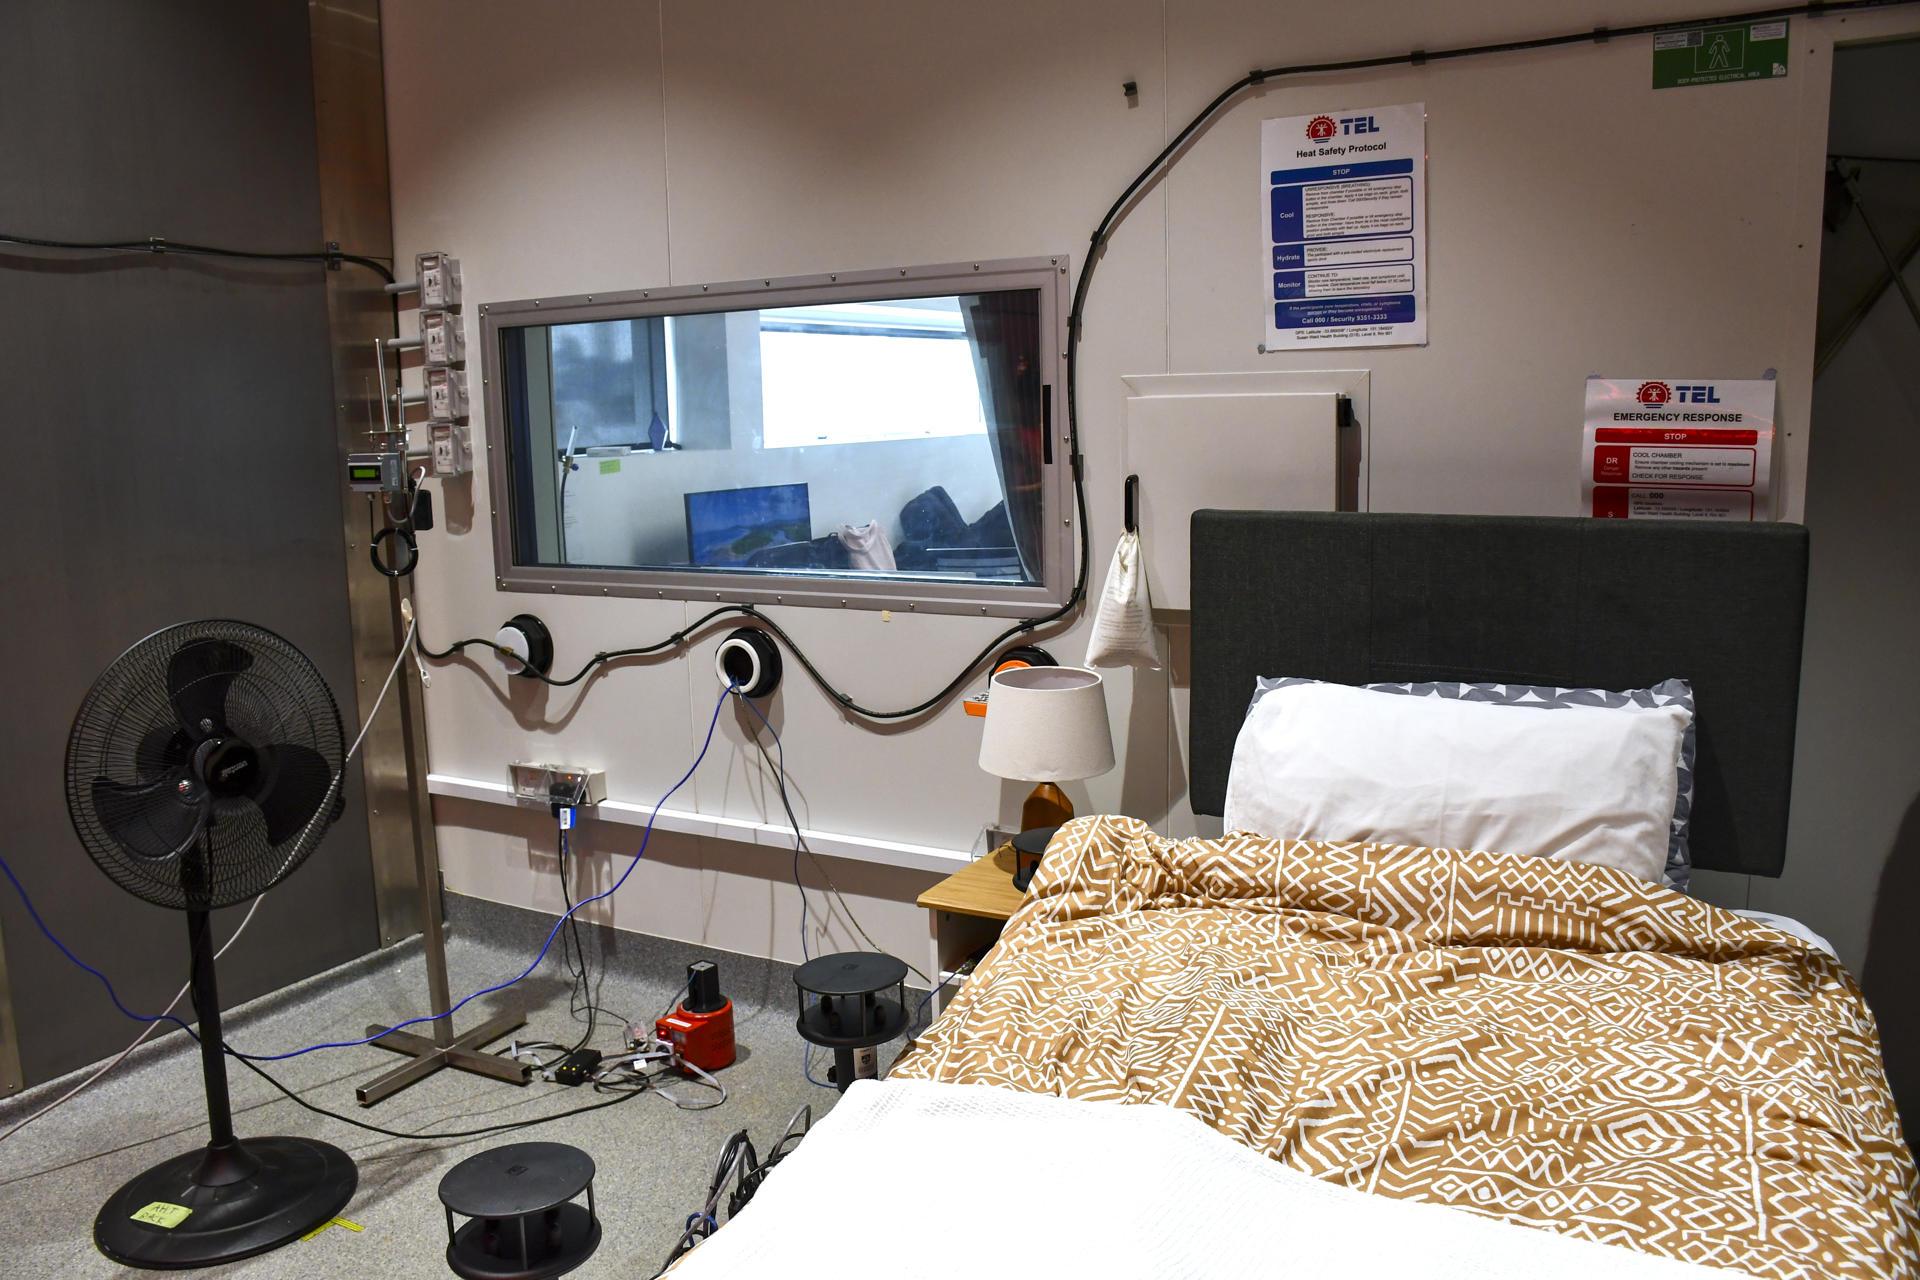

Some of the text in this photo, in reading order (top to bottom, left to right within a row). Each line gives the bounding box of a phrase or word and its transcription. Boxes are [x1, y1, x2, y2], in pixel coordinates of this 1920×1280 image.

[1340, 116, 1380, 135] TEL
[1296, 142, 1387, 158] Heat Safety Protocol
[1332, 168, 1351, 176] STOP
[1279, 211, 1294, 219] Cool
[1277, 253, 1301, 263] Hydrate
[1277, 281, 1301, 289] Monitor
[1330, 315, 1355, 323] Security
[1356, 313, 1388, 321] 9351-3333
[1675, 385, 1720, 404] TEL
[1613, 413, 1743, 422] EMERGENCY RESPONSE
[1664, 433, 1687, 441] STOP
[1649, 492, 1664, 500] 000
